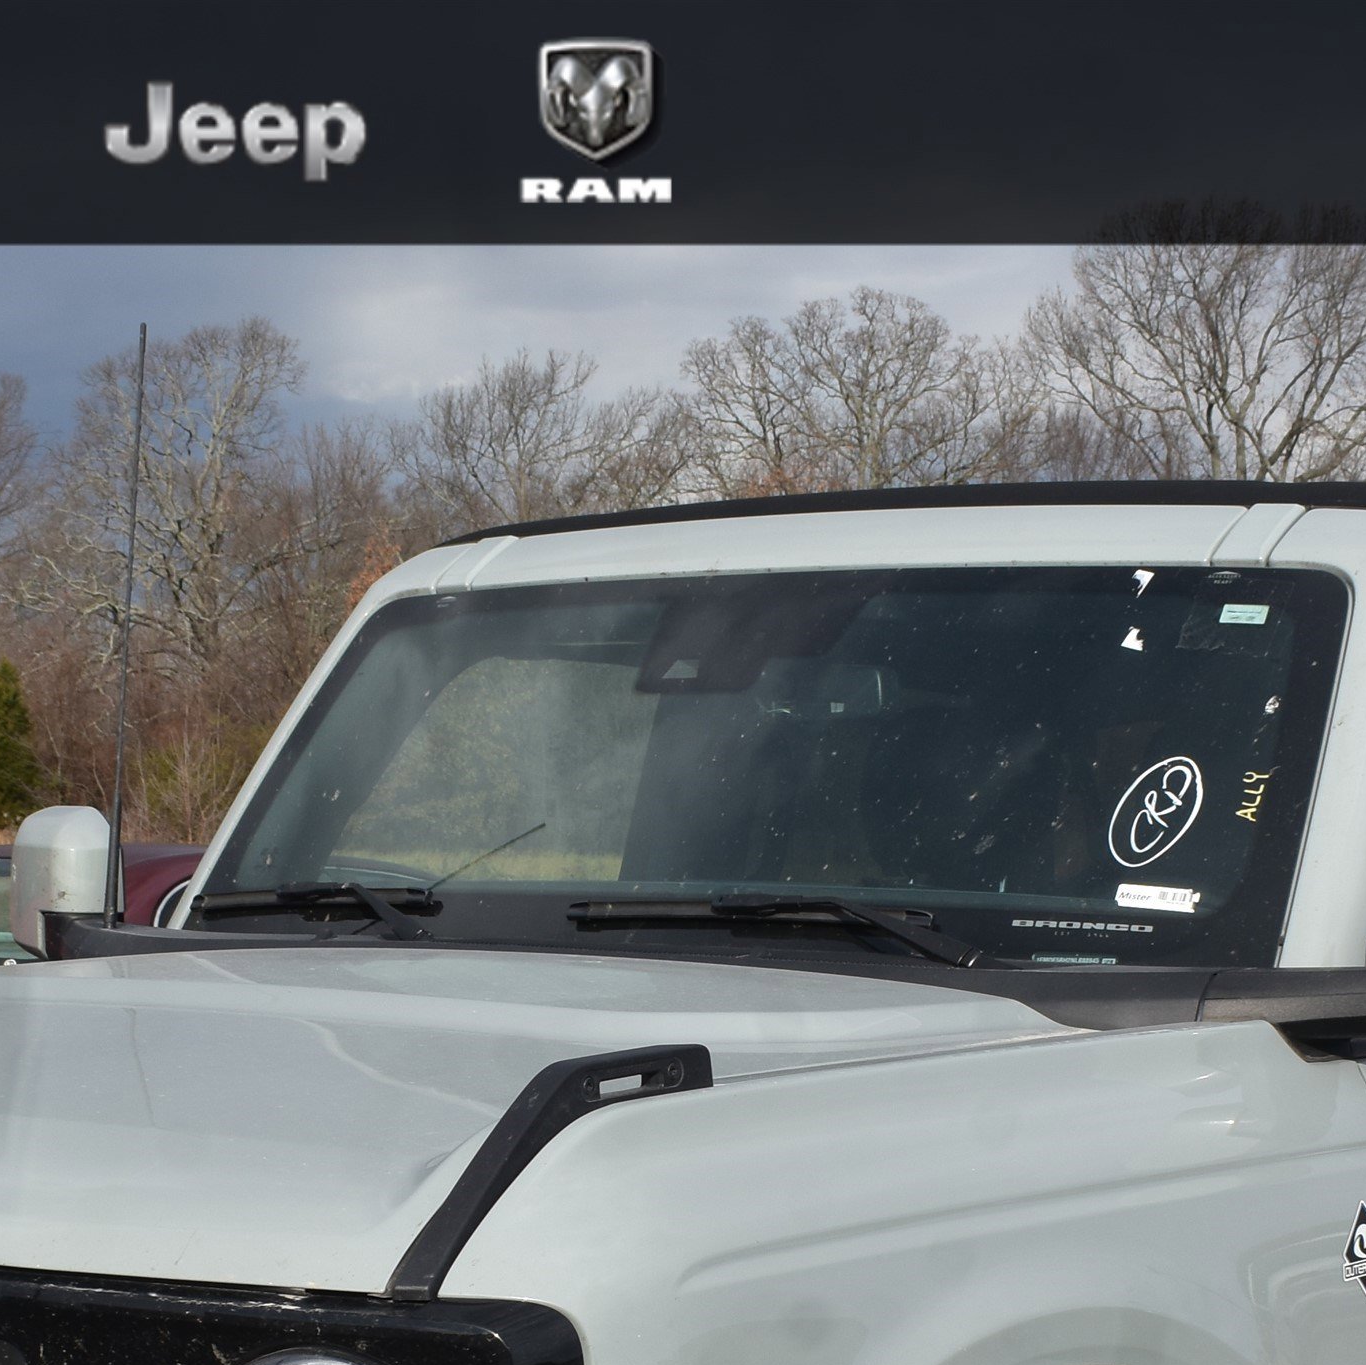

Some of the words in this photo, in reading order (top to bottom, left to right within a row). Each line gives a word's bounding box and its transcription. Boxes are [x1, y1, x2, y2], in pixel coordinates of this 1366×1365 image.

[1235, 770, 1270, 823] ALLY
[1118, 891, 1152, 902] Mister
[1011, 919, 1154, 933] BRONCO
[1345, 1262, 1366, 1277] OUTER
